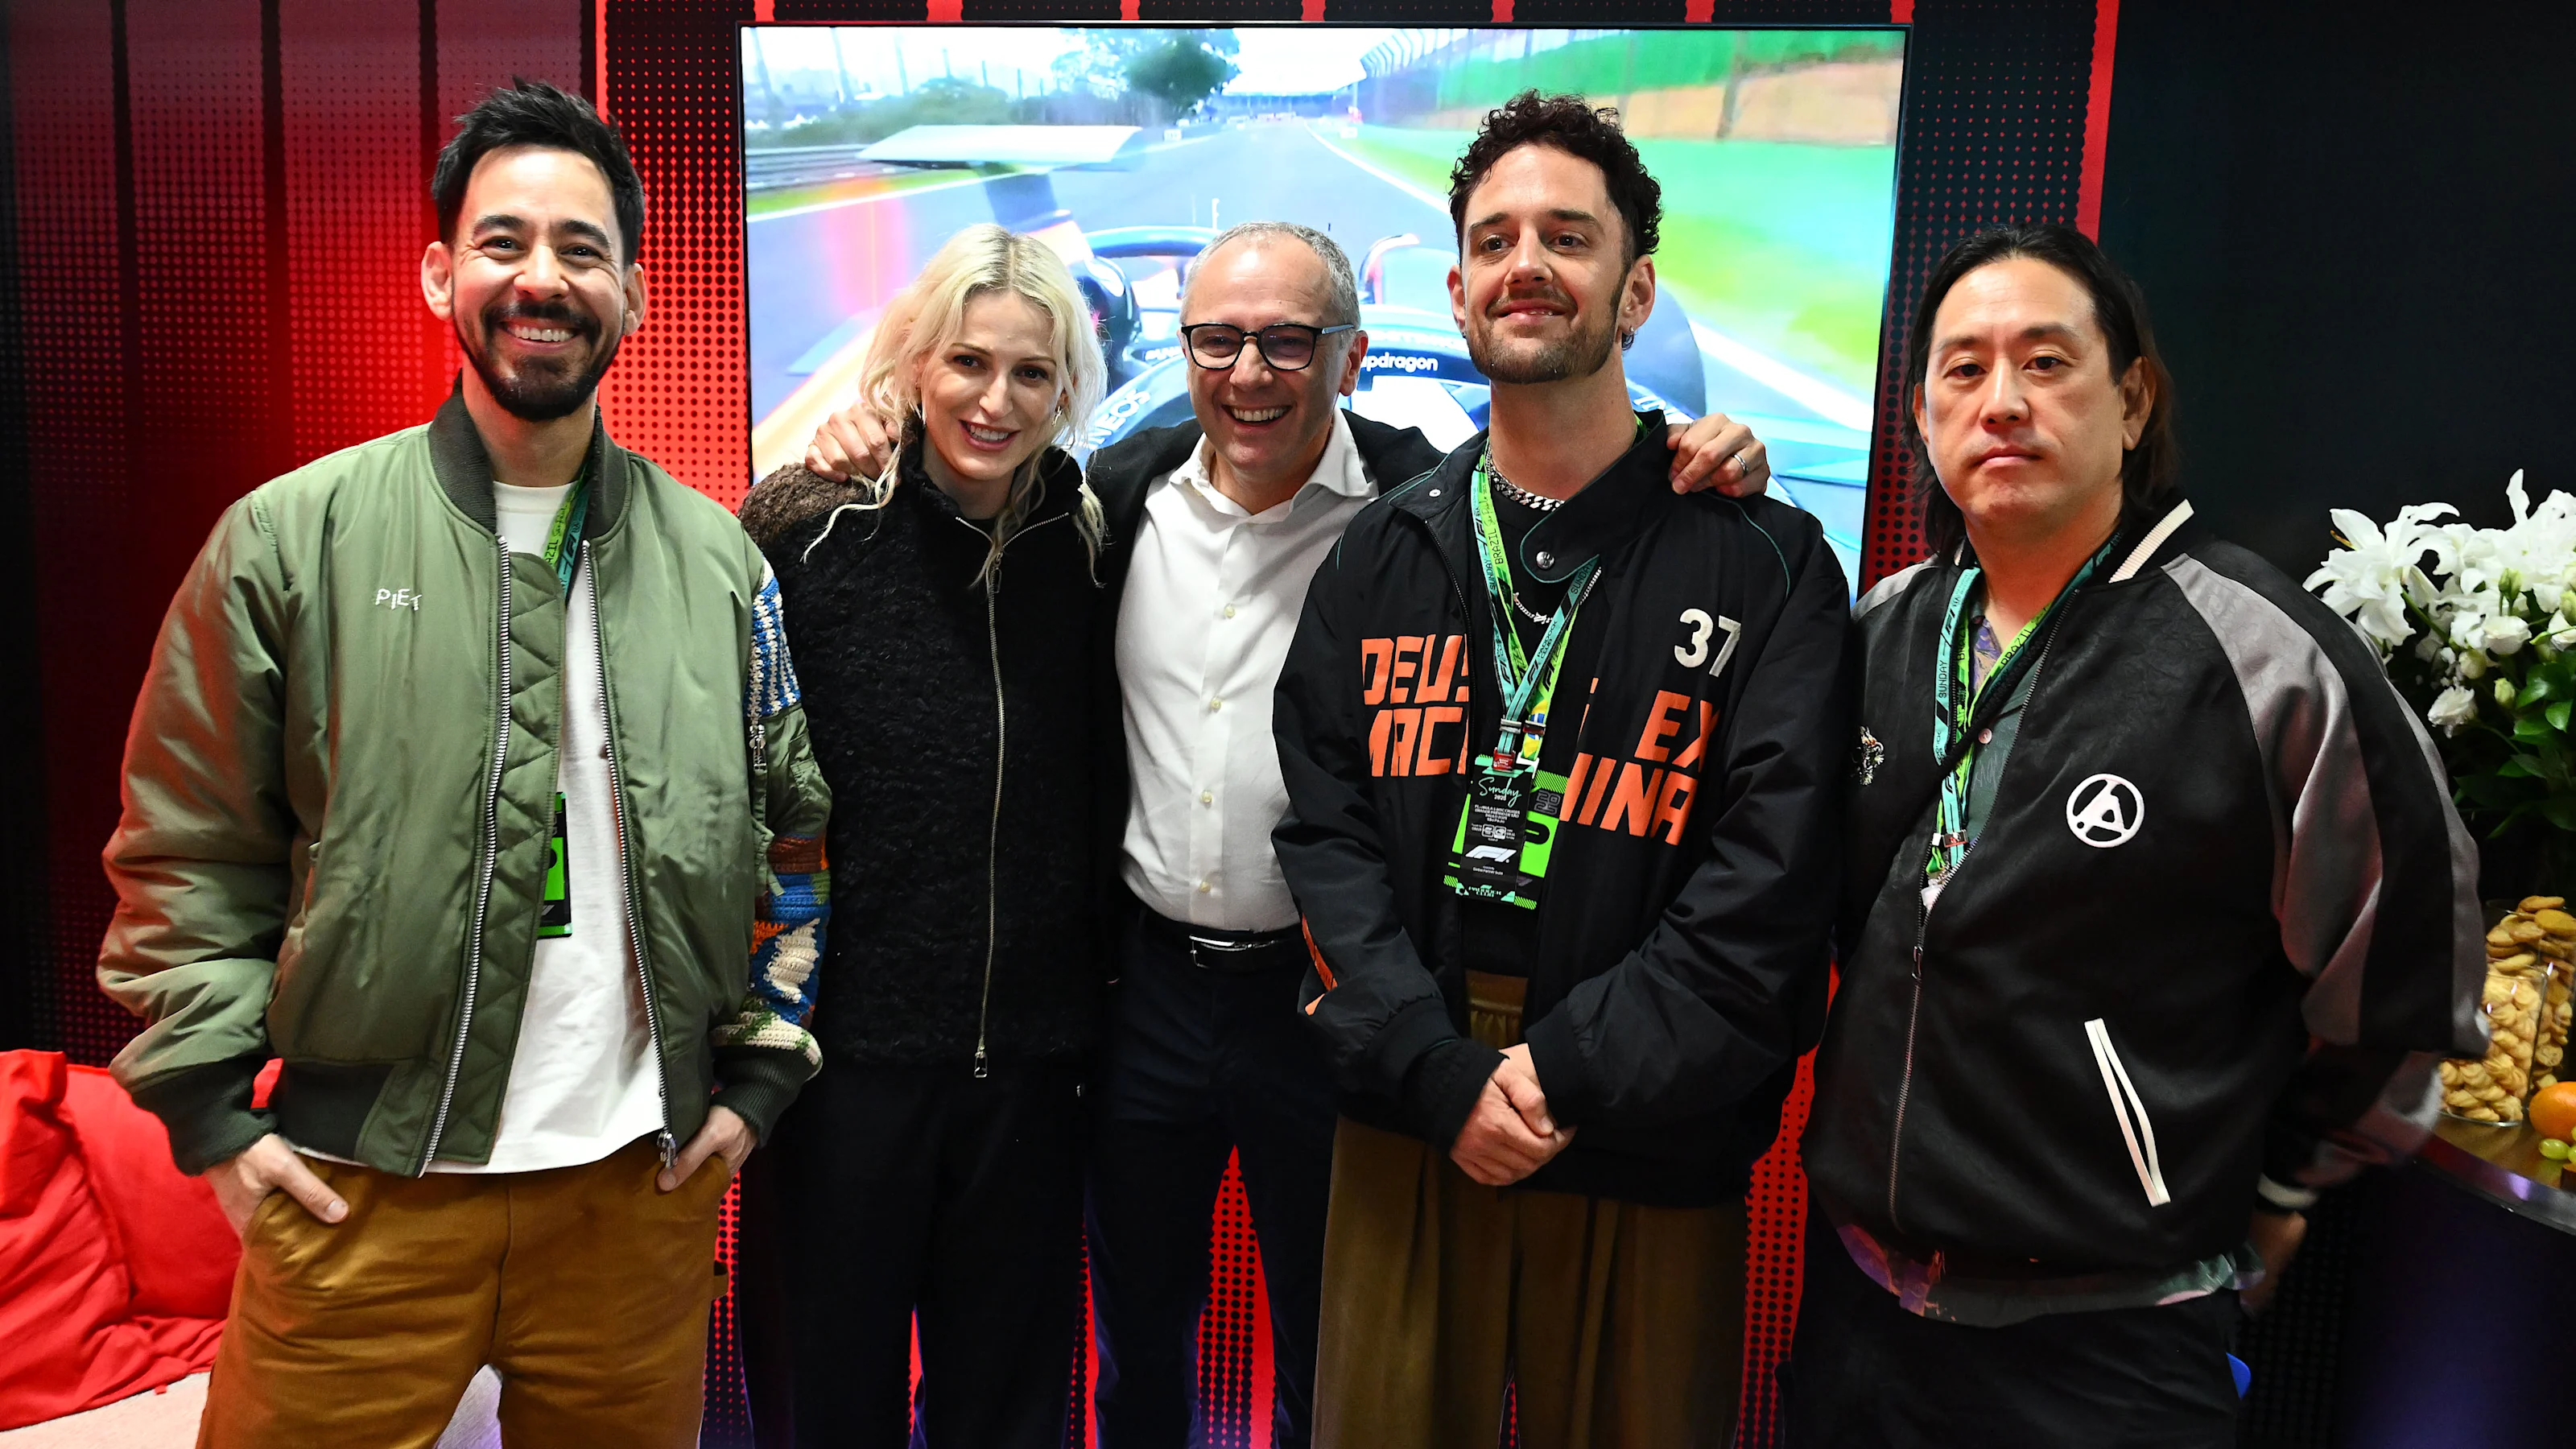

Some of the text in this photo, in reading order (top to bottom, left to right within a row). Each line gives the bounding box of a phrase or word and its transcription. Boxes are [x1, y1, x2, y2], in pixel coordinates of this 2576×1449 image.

[1488, 528, 1504, 564] BRAZIL
[1484, 559, 1496, 590] SUNDAY
[375, 588, 423, 611] PIET
[1537, 621, 1558, 657] PADDOCK
[1541, 638, 1552, 659] CLUB
[1674, 609, 1741, 677] 37
[1938, 660, 1948, 699] SUNDAY
[1634, 690, 1720, 773] EX
[1478, 777, 1522, 808] Sunday
